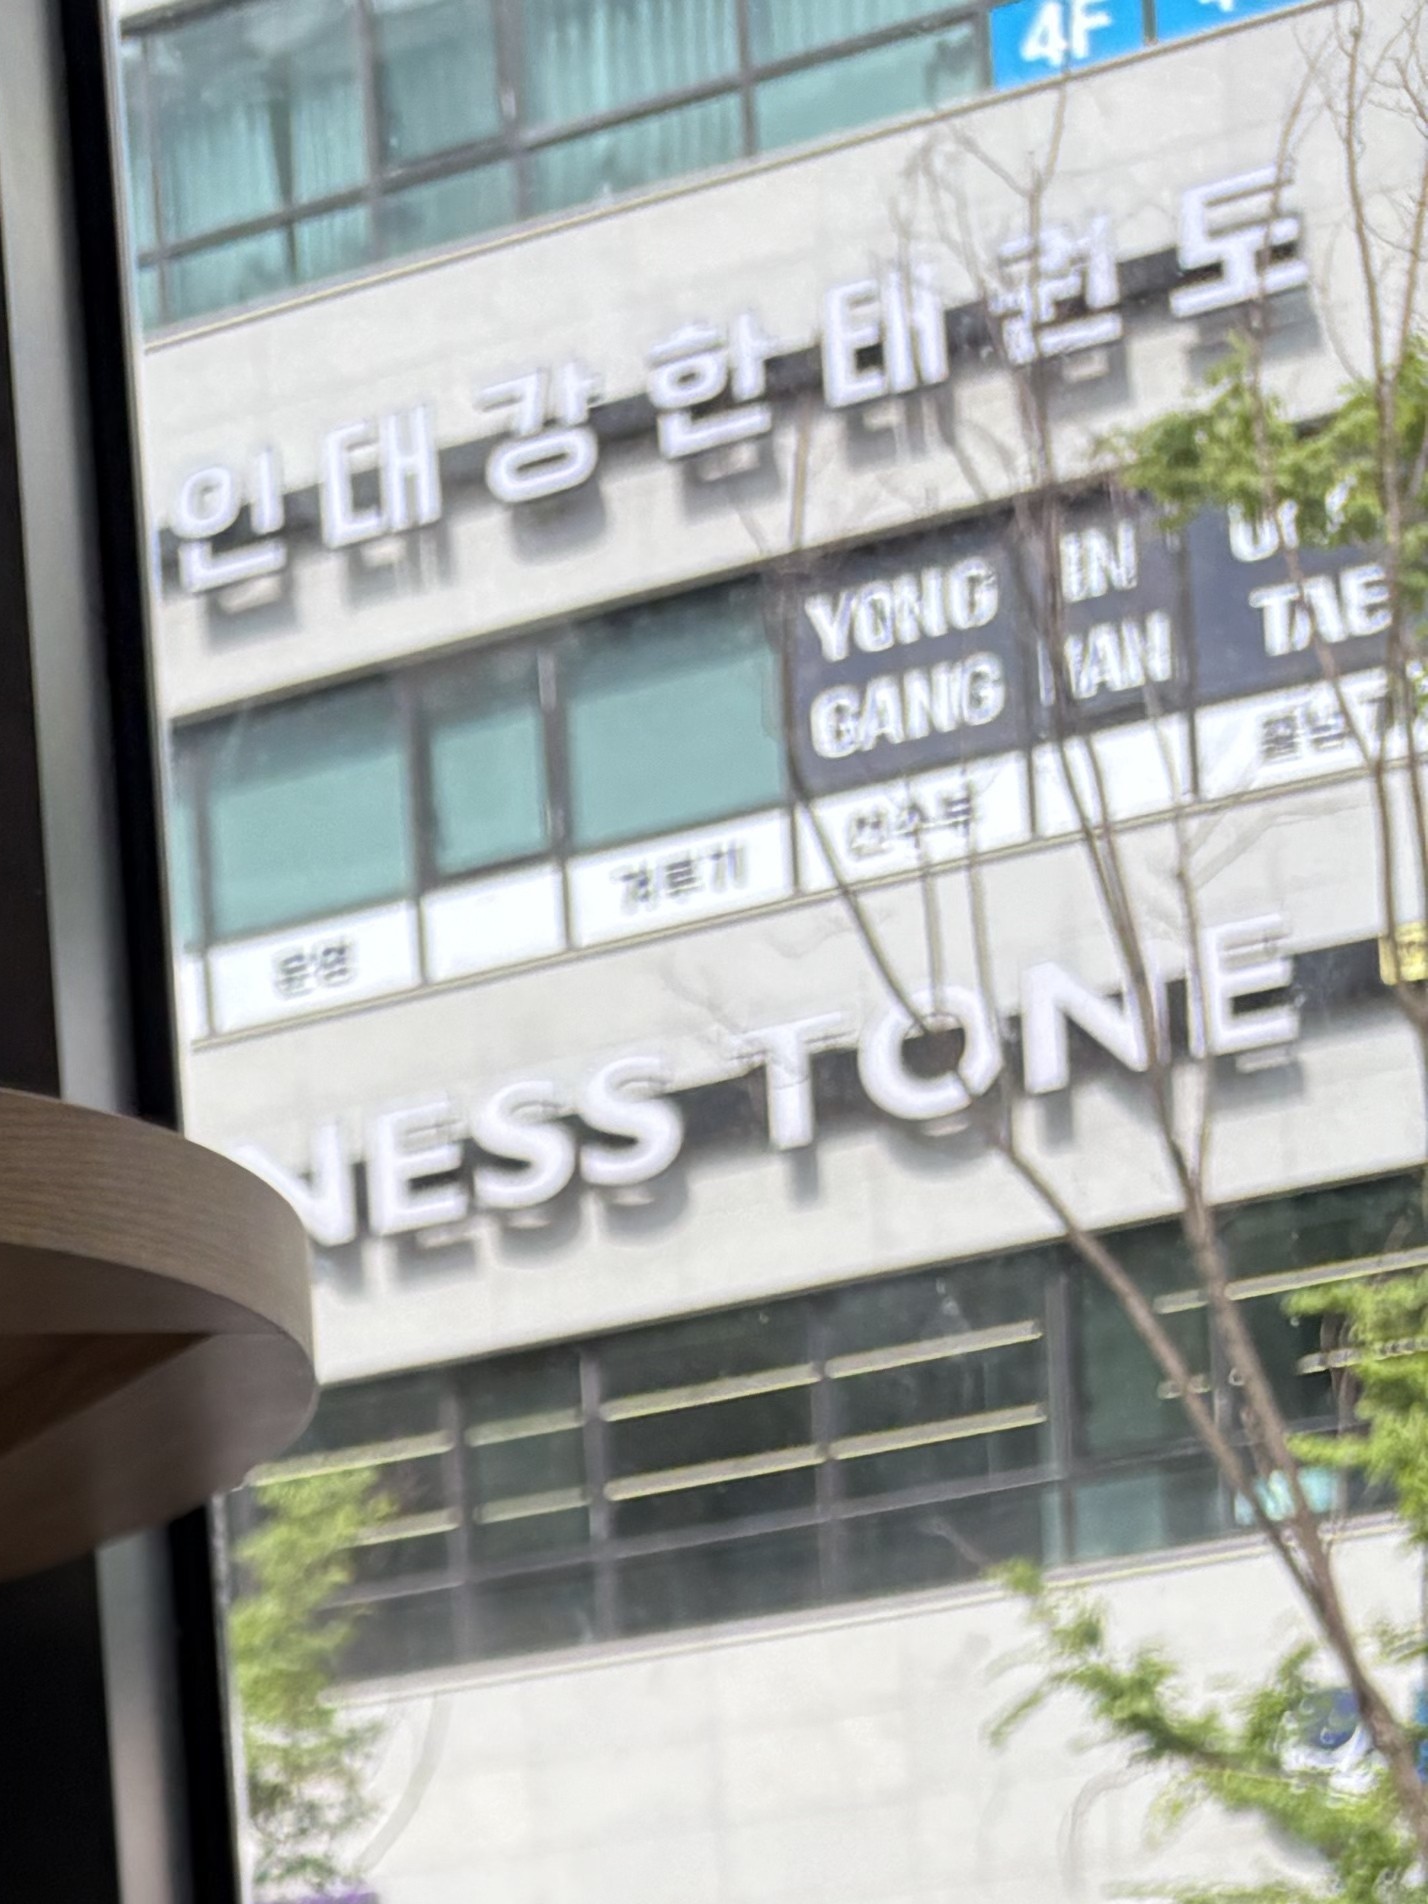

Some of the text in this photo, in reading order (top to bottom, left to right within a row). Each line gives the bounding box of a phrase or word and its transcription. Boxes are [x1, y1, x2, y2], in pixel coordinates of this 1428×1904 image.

[1018, 0, 1111, 66] 4F
[805, 520, 1139, 663] YONG IN
[808, 649, 1006, 760] GANG
[731, 915, 1301, 1149] TONE
